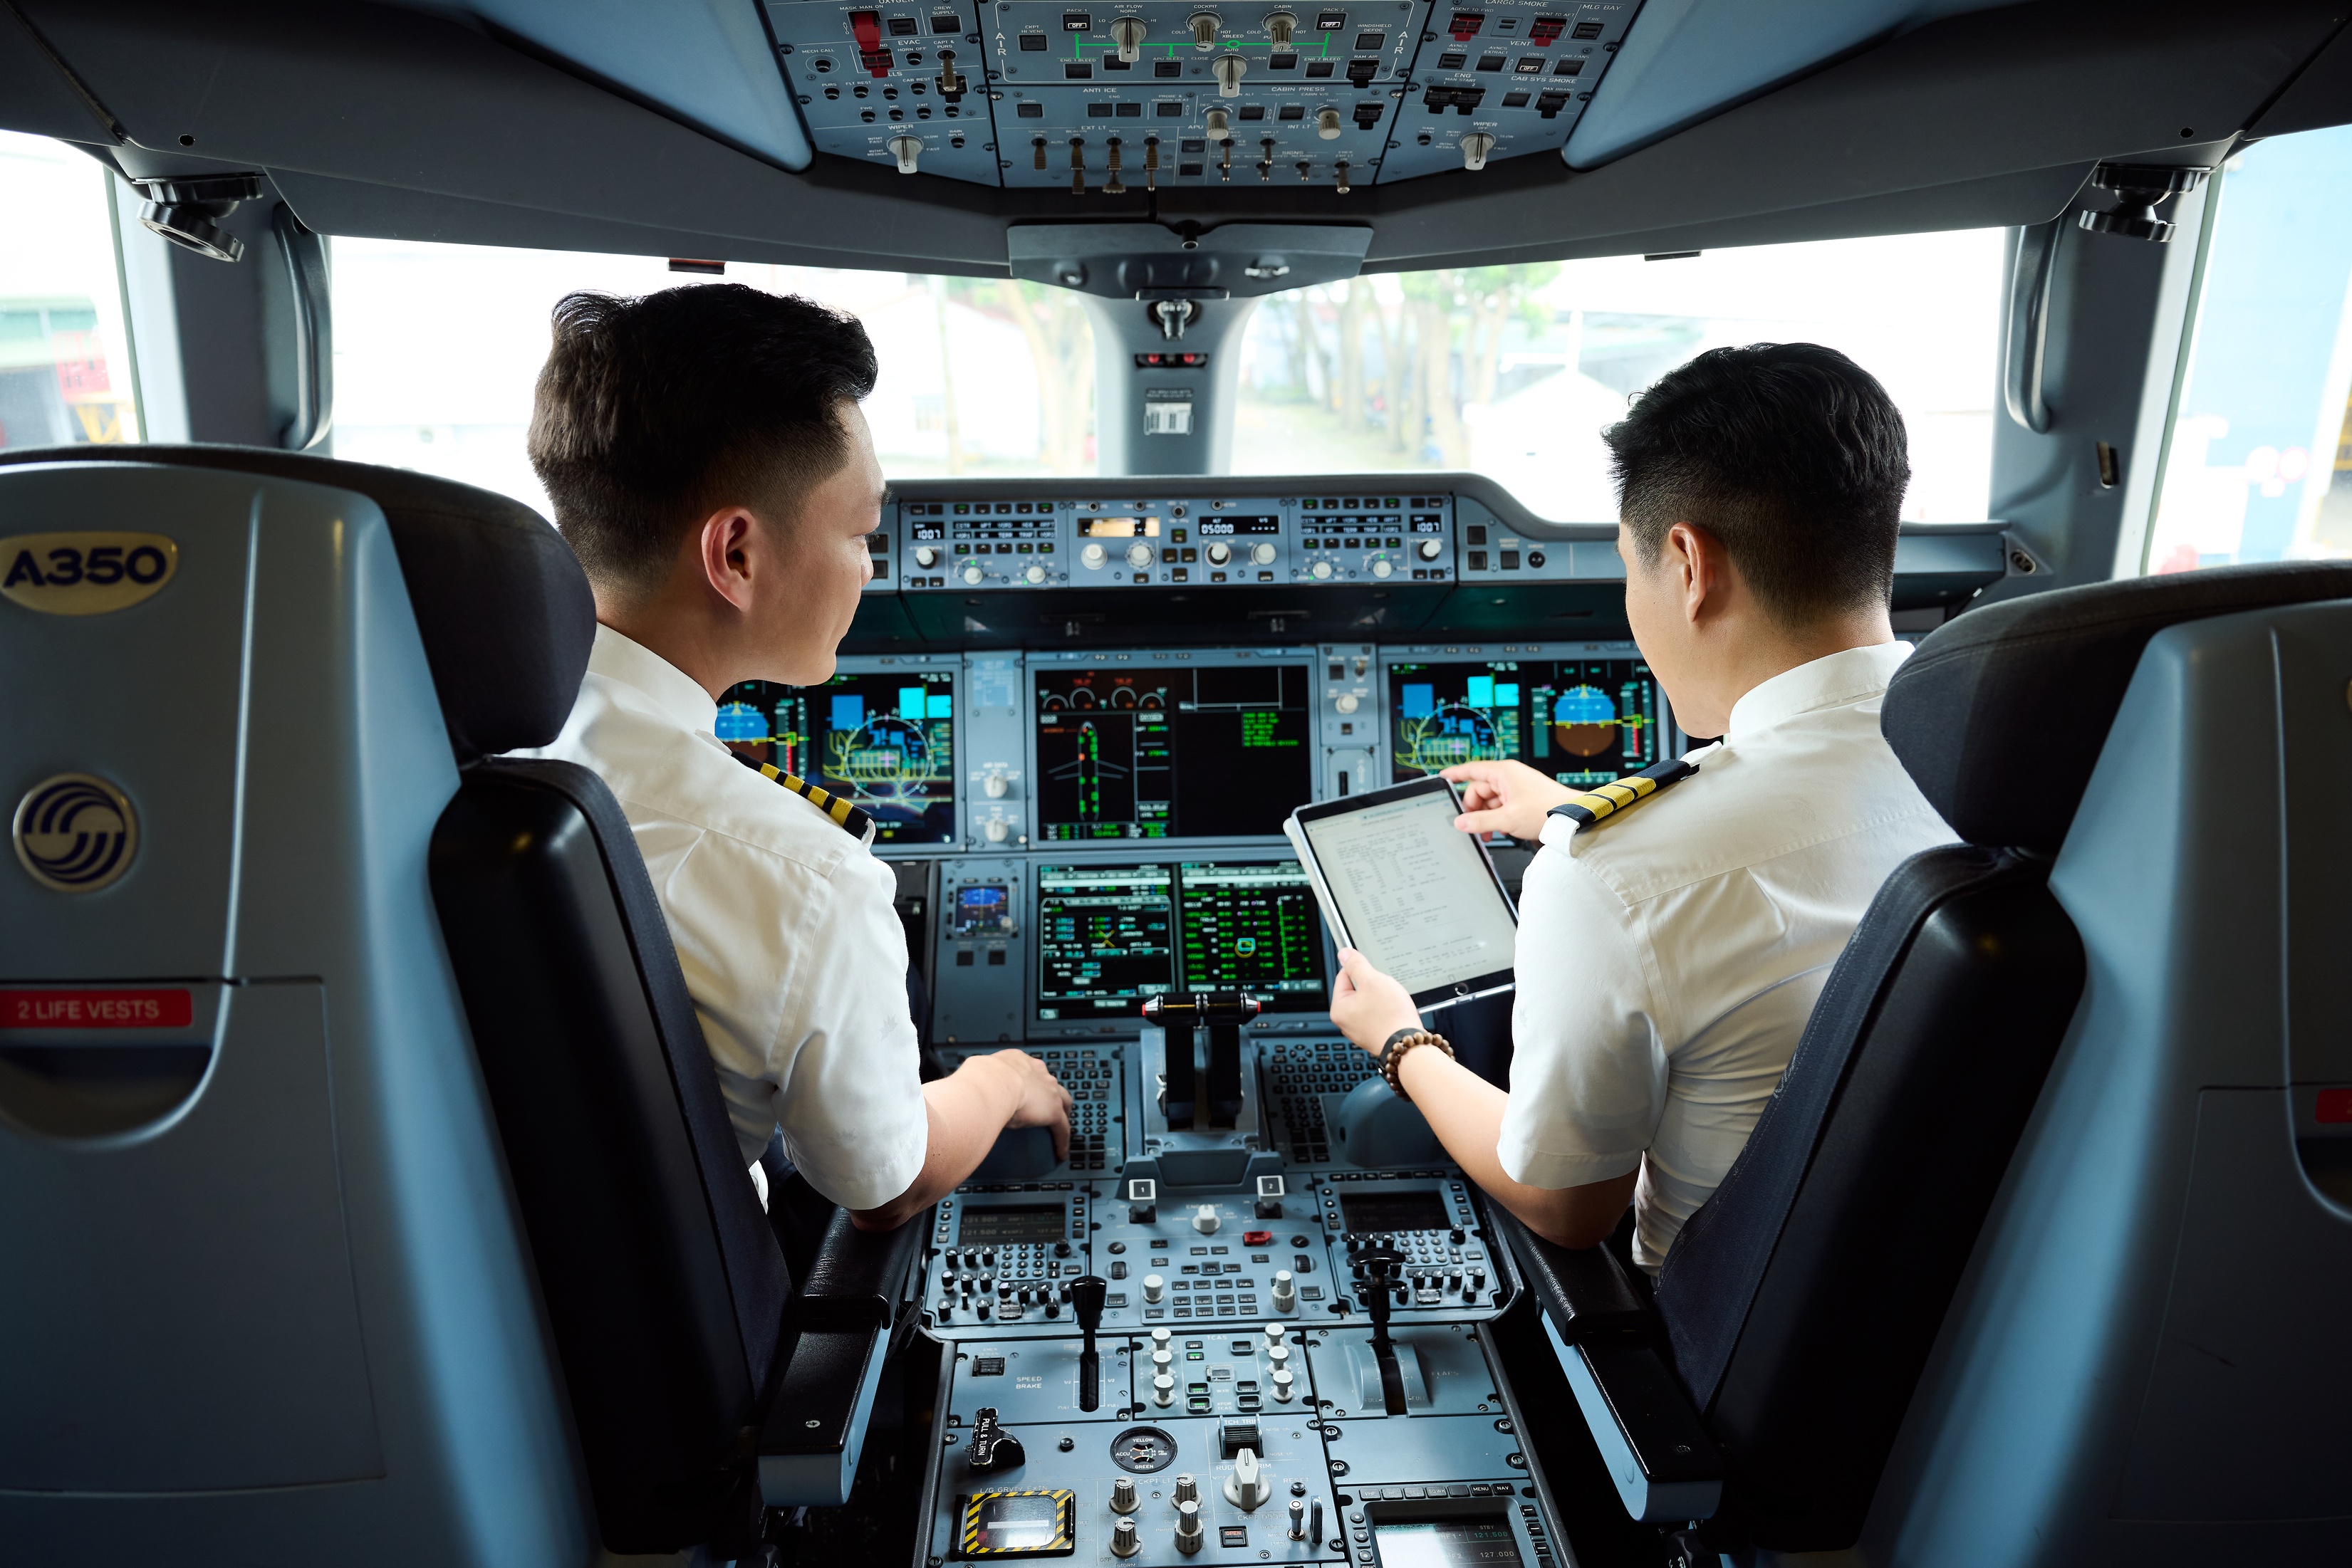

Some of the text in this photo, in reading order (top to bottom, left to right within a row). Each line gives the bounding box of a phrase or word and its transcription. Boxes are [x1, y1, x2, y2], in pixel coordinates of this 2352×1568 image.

[3, 545, 167, 588] A350
[18, 999, 160, 1020] 2 LIFE VESTS
[981, 1418, 990, 1432] PULL
[977, 1440, 987, 1455] TURN
